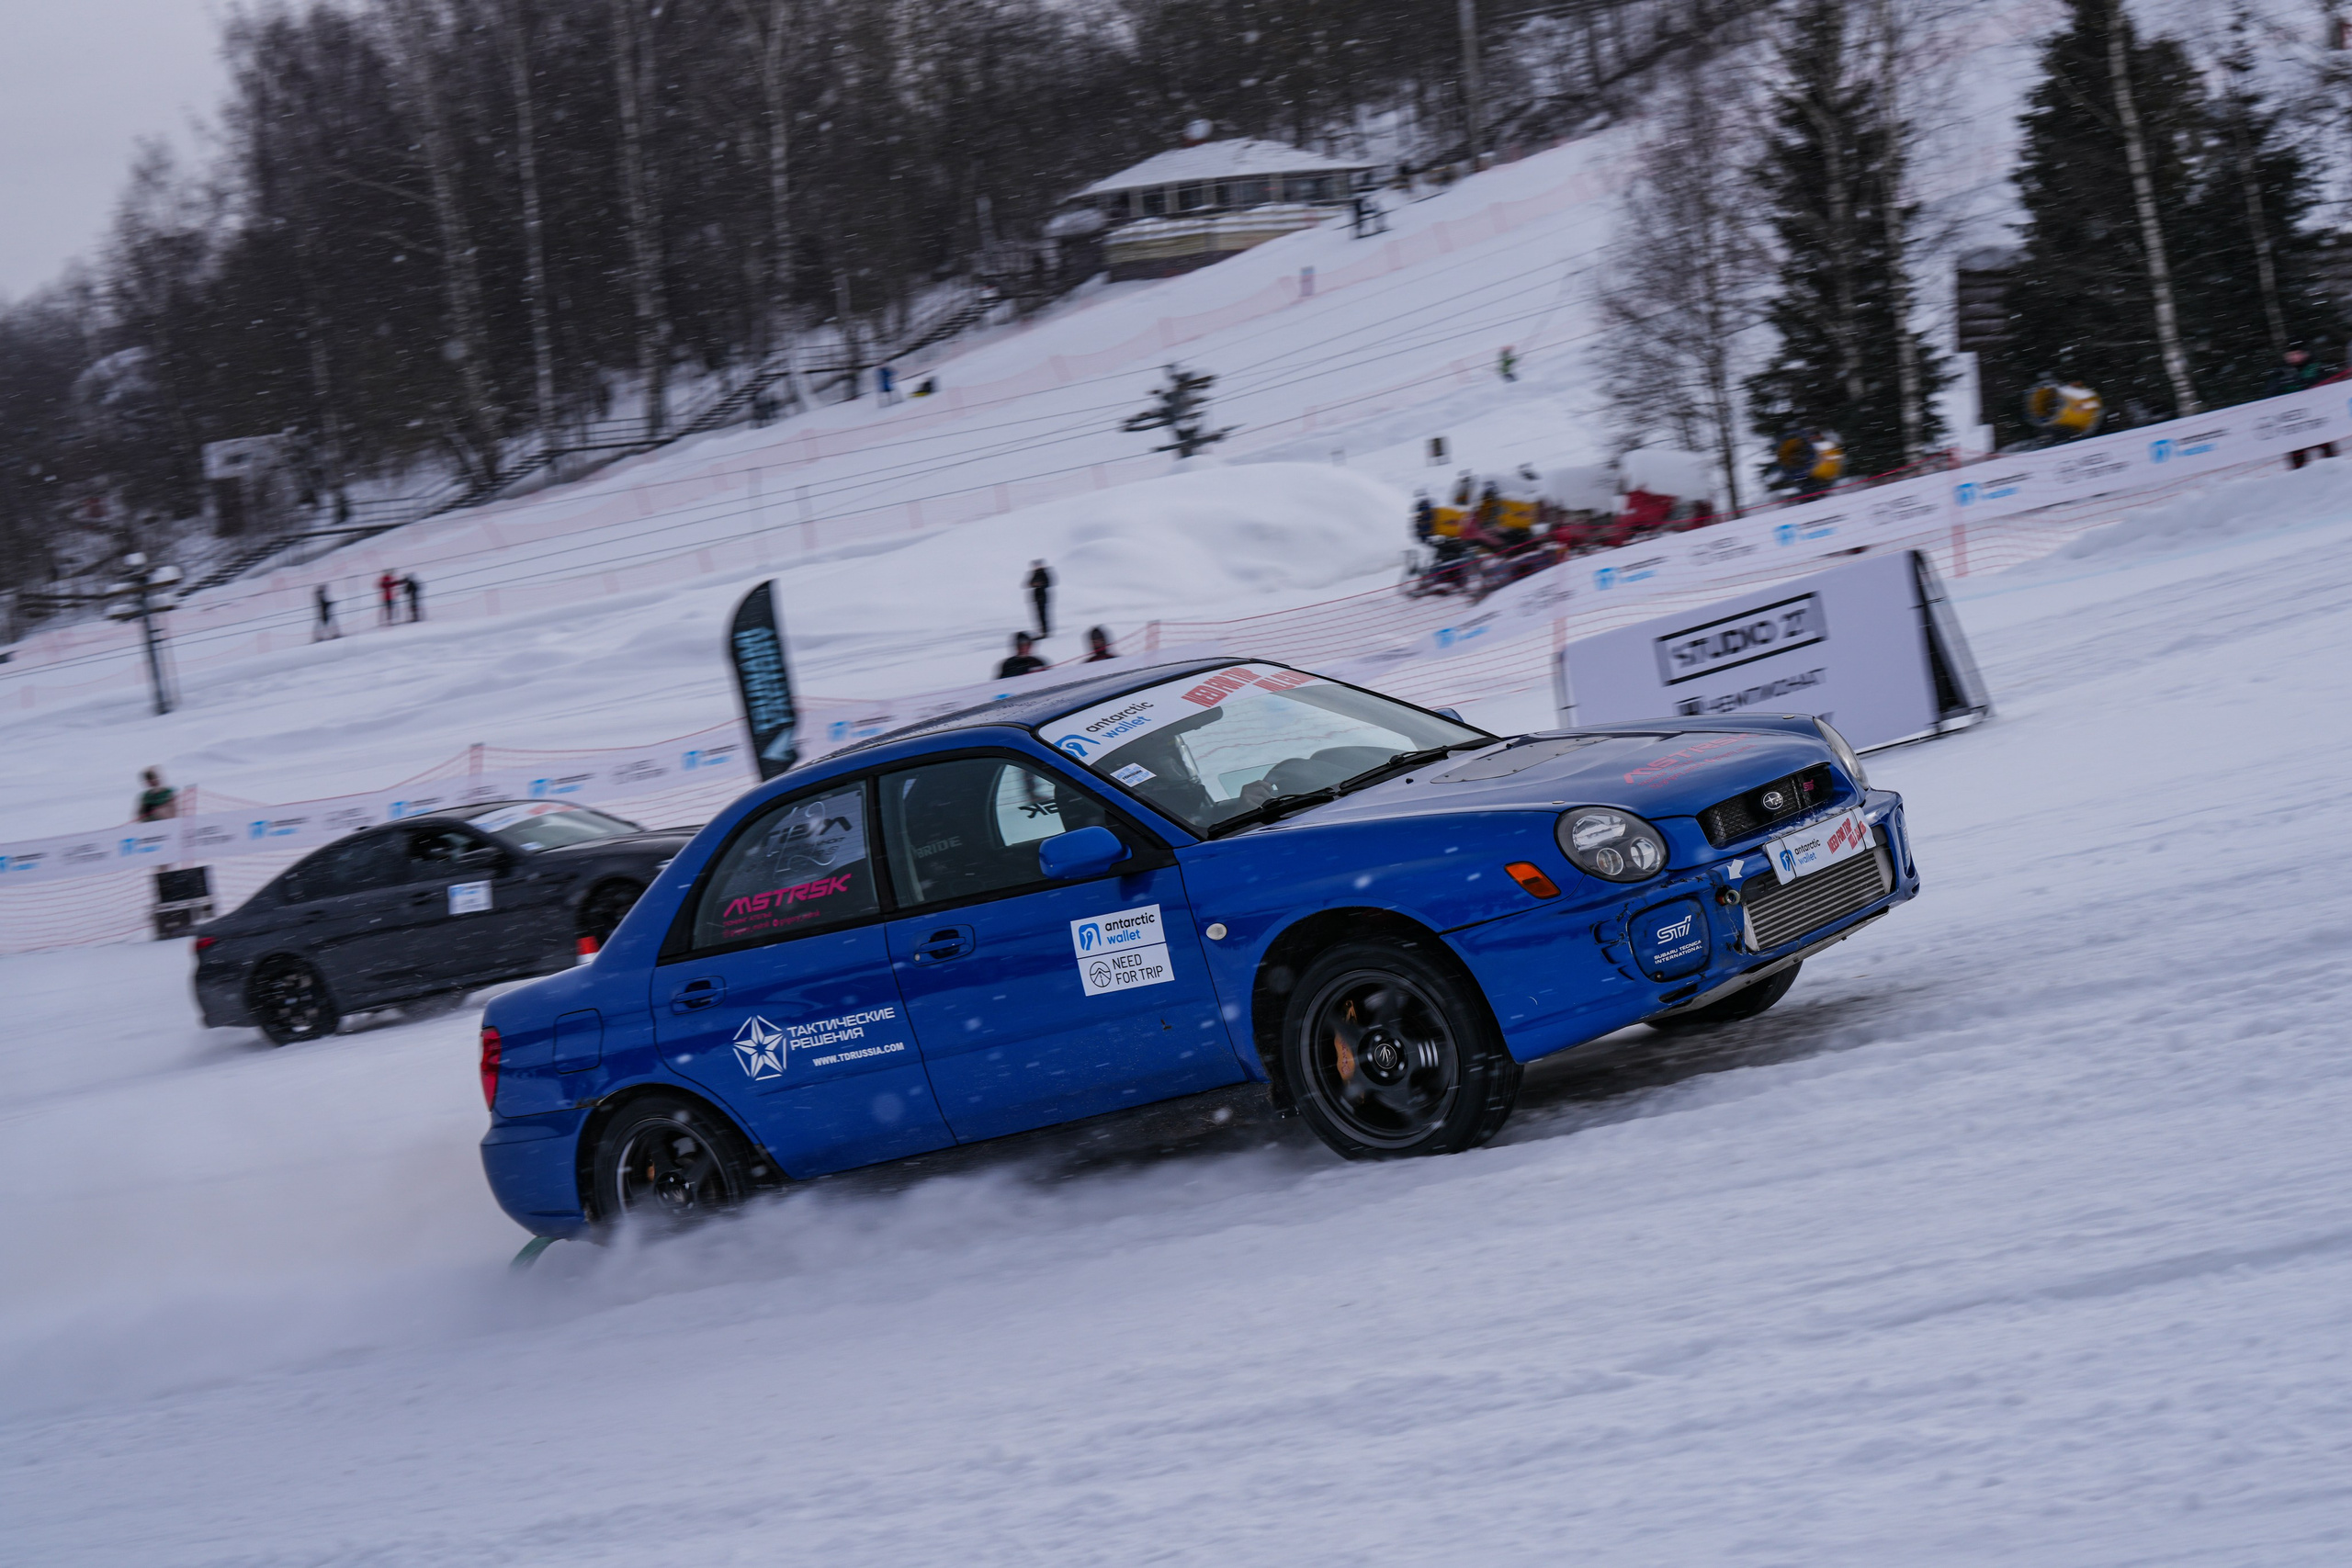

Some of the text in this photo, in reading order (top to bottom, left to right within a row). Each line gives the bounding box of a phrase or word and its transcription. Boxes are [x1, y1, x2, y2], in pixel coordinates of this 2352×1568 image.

[1671, 619, 1779, 668] STUDIO
[1086, 702, 1154, 732] antarctic
[1102, 716, 1151, 739] wallet
[917, 835, 962, 859] BRIDE
[1794, 839, 1821, 855] antarctic
[1798, 852, 1817, 864] wallet
[723, 873, 853, 918] MSTRSK
[1105, 912, 1155, 931] antarctic
[1107, 929, 1141, 945] wallet
[1654, 940, 1702, 960] SUBARU TECNICA
[1655, 945, 1703, 964] INTERNATIONAL
[1113, 953, 1143, 970] NEED
[1115, 965, 1164, 985] FOR TRIP
[786, 1007, 896, 1038] ТАКТИЧЕСКИЕ
[790, 1027, 865, 1051] РЕШЕНИЯ
[813, 1042, 905, 1066] WWW.TDRUSSIA.COM
